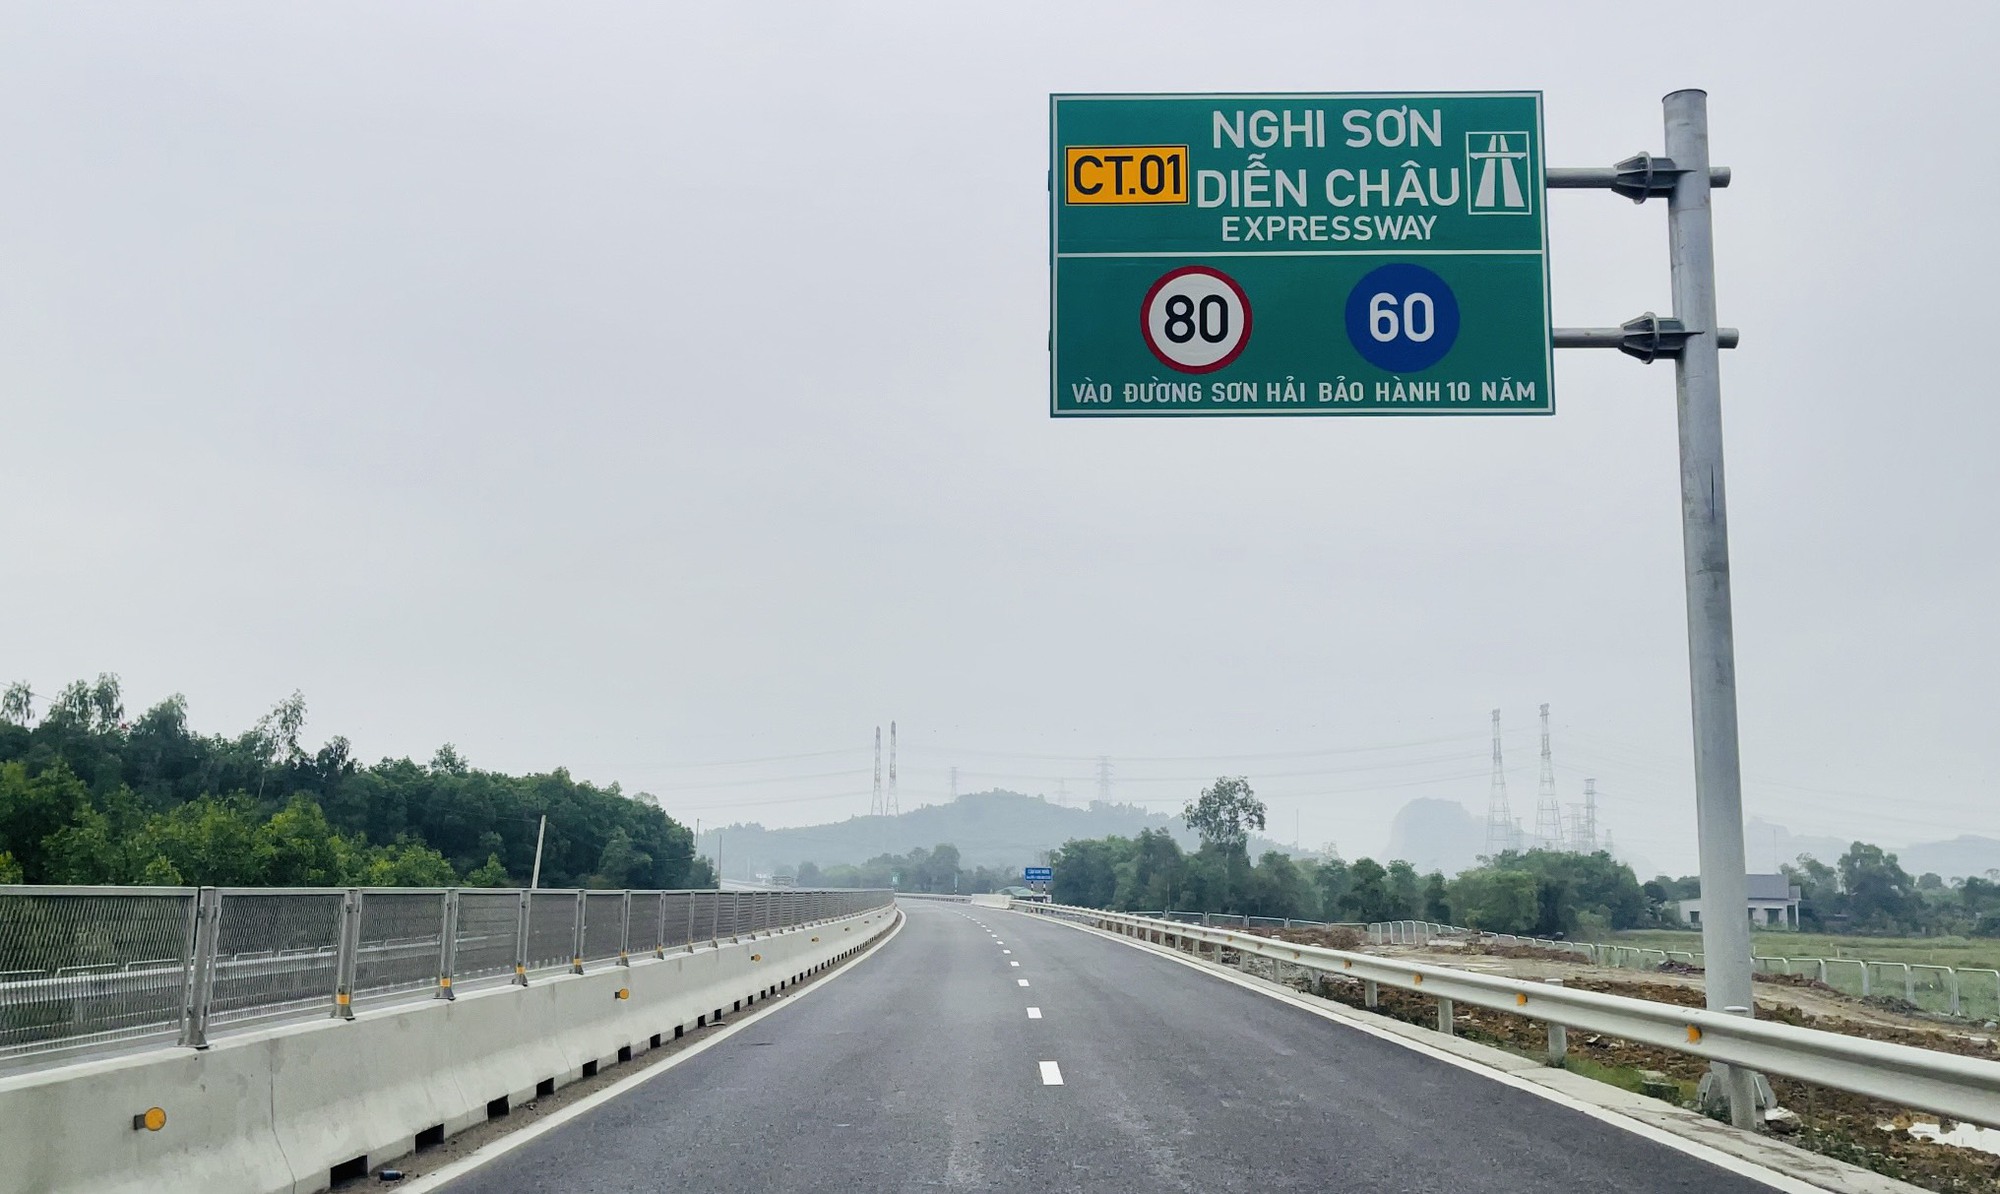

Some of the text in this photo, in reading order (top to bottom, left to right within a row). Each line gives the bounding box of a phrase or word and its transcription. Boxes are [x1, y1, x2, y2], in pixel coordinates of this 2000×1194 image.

[1213, 105, 1442, 148] NGHI SƠN
[1073, 154, 1181, 196] CT.01
[1198, 153, 1460, 208] DIỄN CHÂU
[1222, 215, 1438, 242] EXPRESSWAY
[1164, 294, 1229, 344] 80
[1370, 293, 1434, 342] 60
[1071, 375, 1535, 403] VÀO ĐƯỜNG SƠN HẢI BẢO HÀNH 10 NĂM
